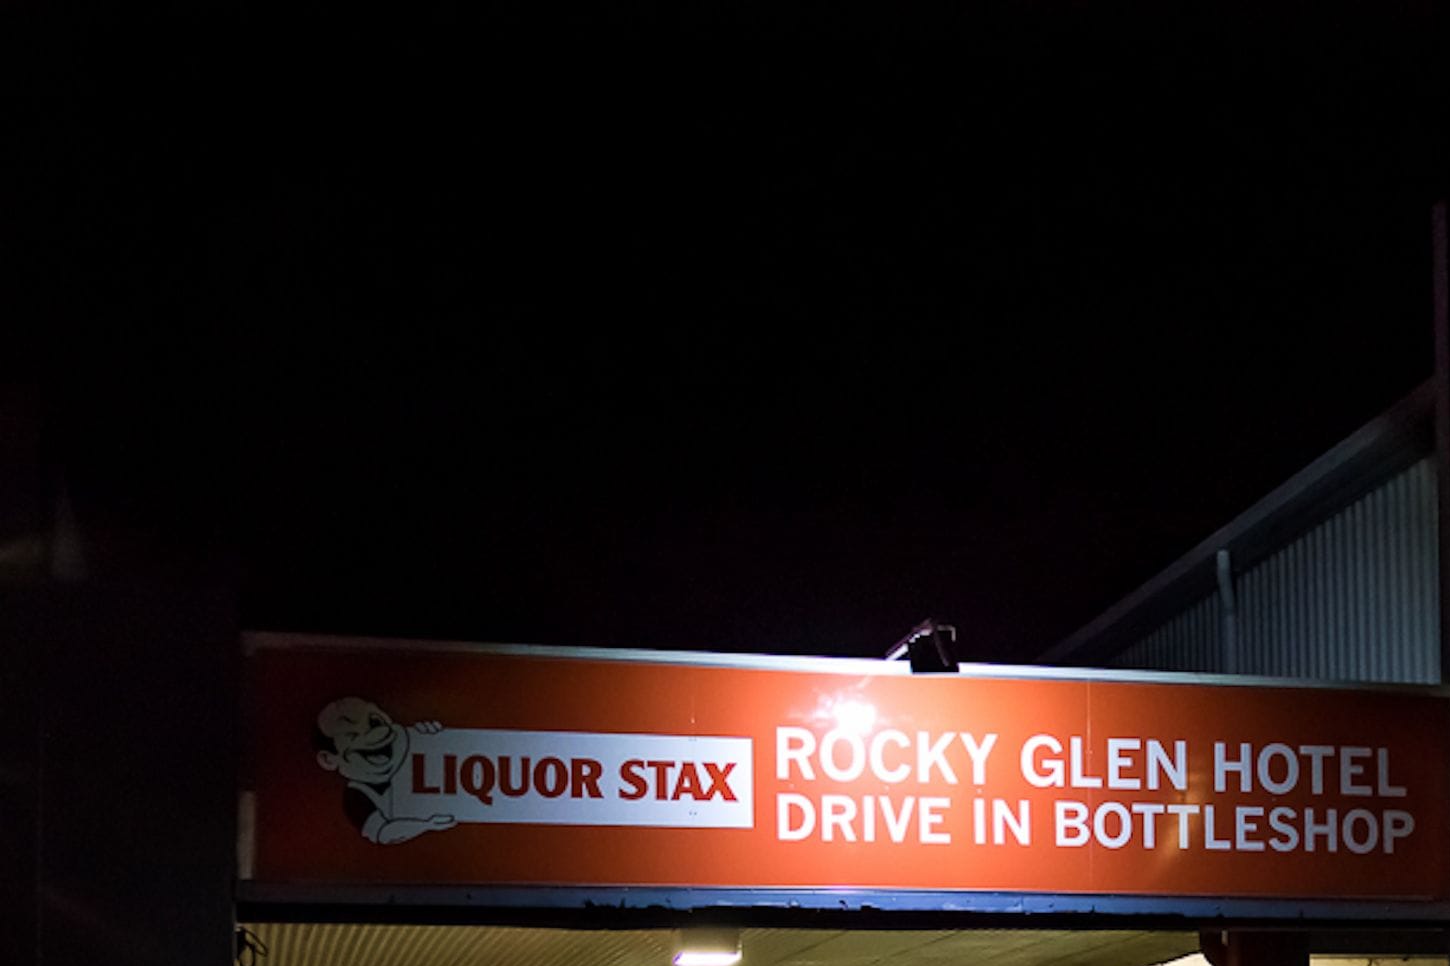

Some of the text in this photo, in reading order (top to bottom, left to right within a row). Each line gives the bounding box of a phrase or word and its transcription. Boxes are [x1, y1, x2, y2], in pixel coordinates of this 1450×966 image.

[412, 753, 738, 806] LIQUOR STAX
[775, 726, 1408, 798] ROCKY GLEN HOTEL
[776, 794, 1415, 854] DRIVE IN BOTTLESHOP
